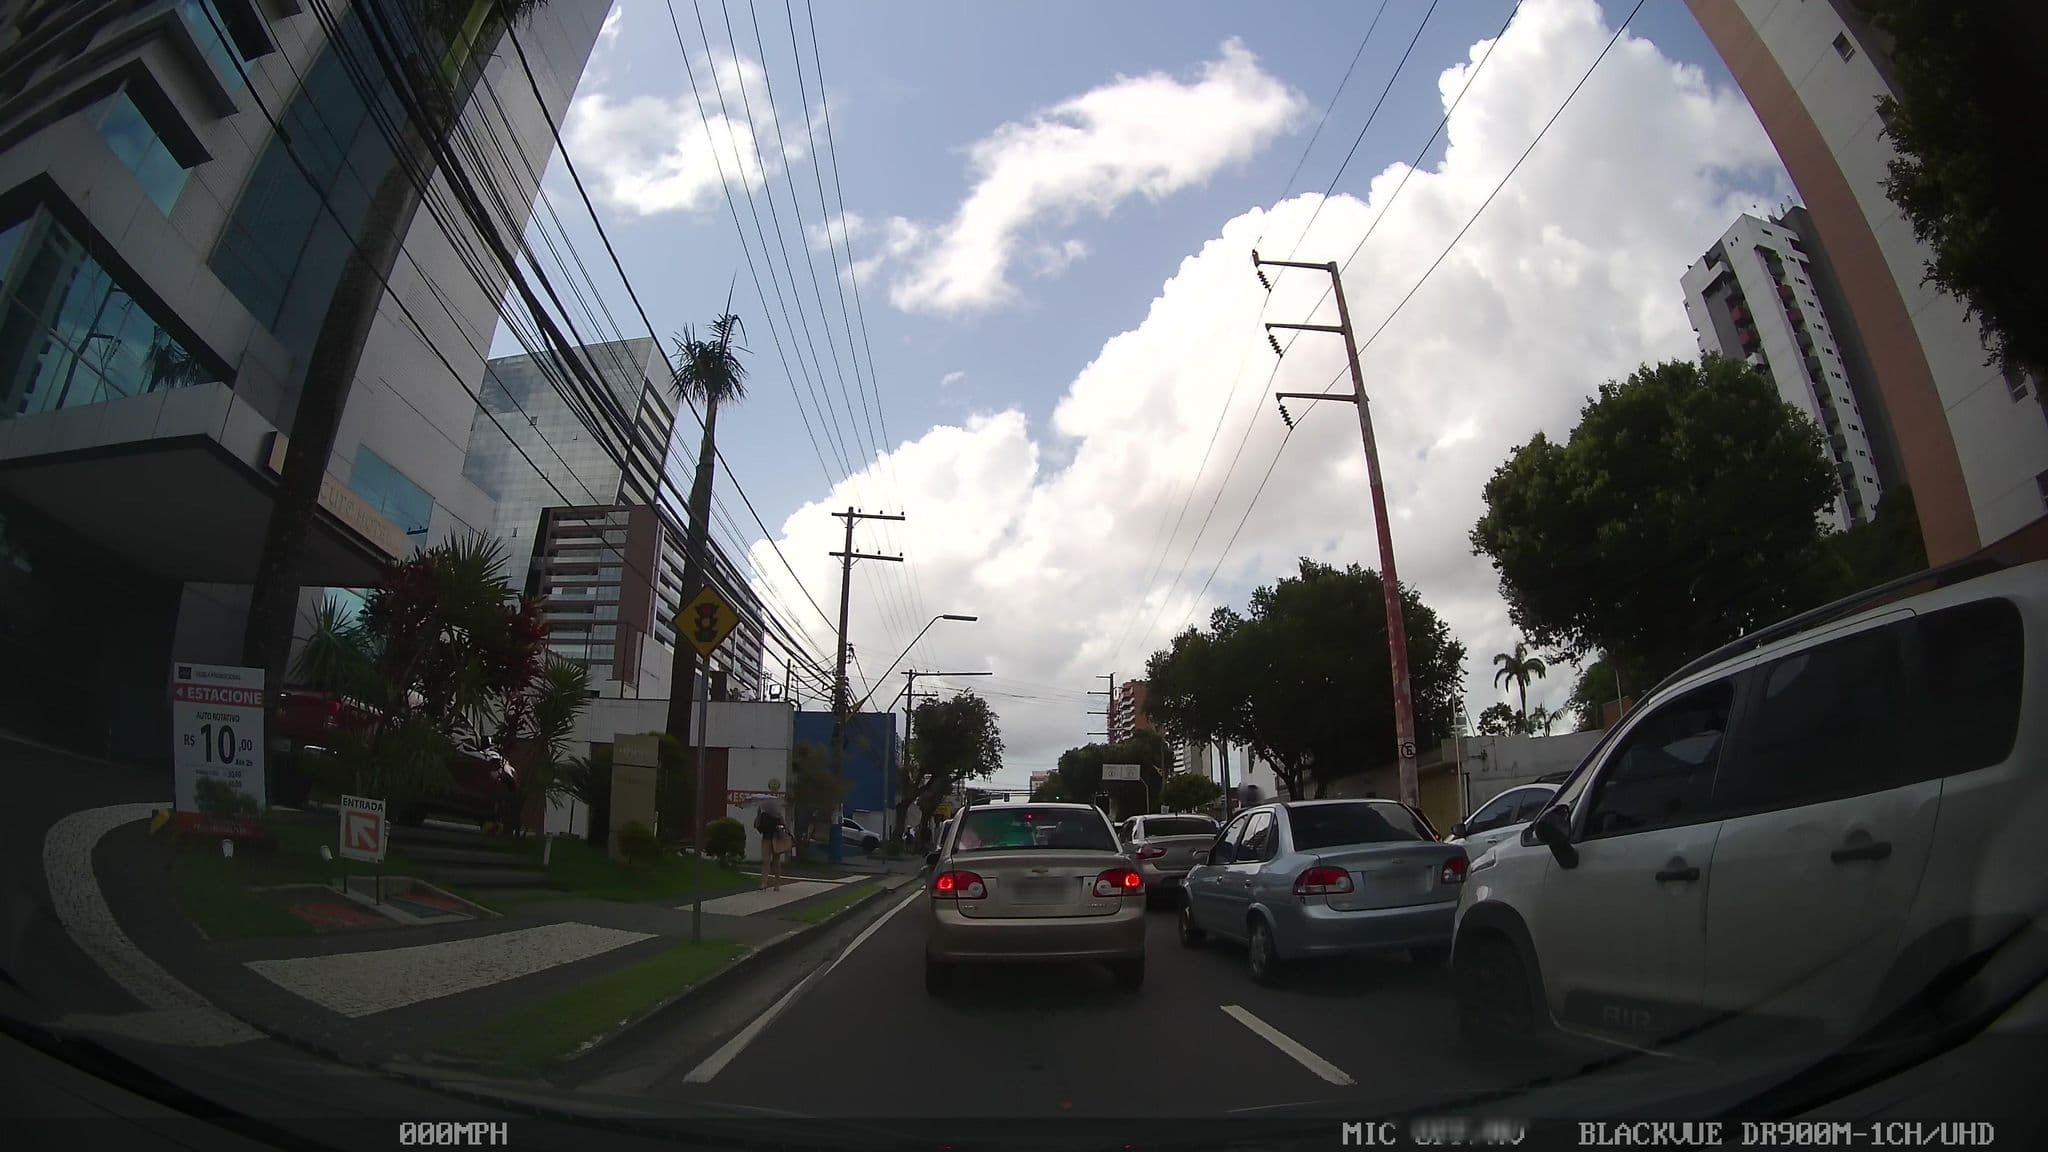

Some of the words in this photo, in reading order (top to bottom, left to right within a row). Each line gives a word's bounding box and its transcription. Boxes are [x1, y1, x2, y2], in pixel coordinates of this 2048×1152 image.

[187, 687, 263, 705] ESTACIONE
[196, 711, 211, 720] AUTO
[212, 712, 240, 722] ROTATIVO
[343, 797, 383, 812] ENTRADA
